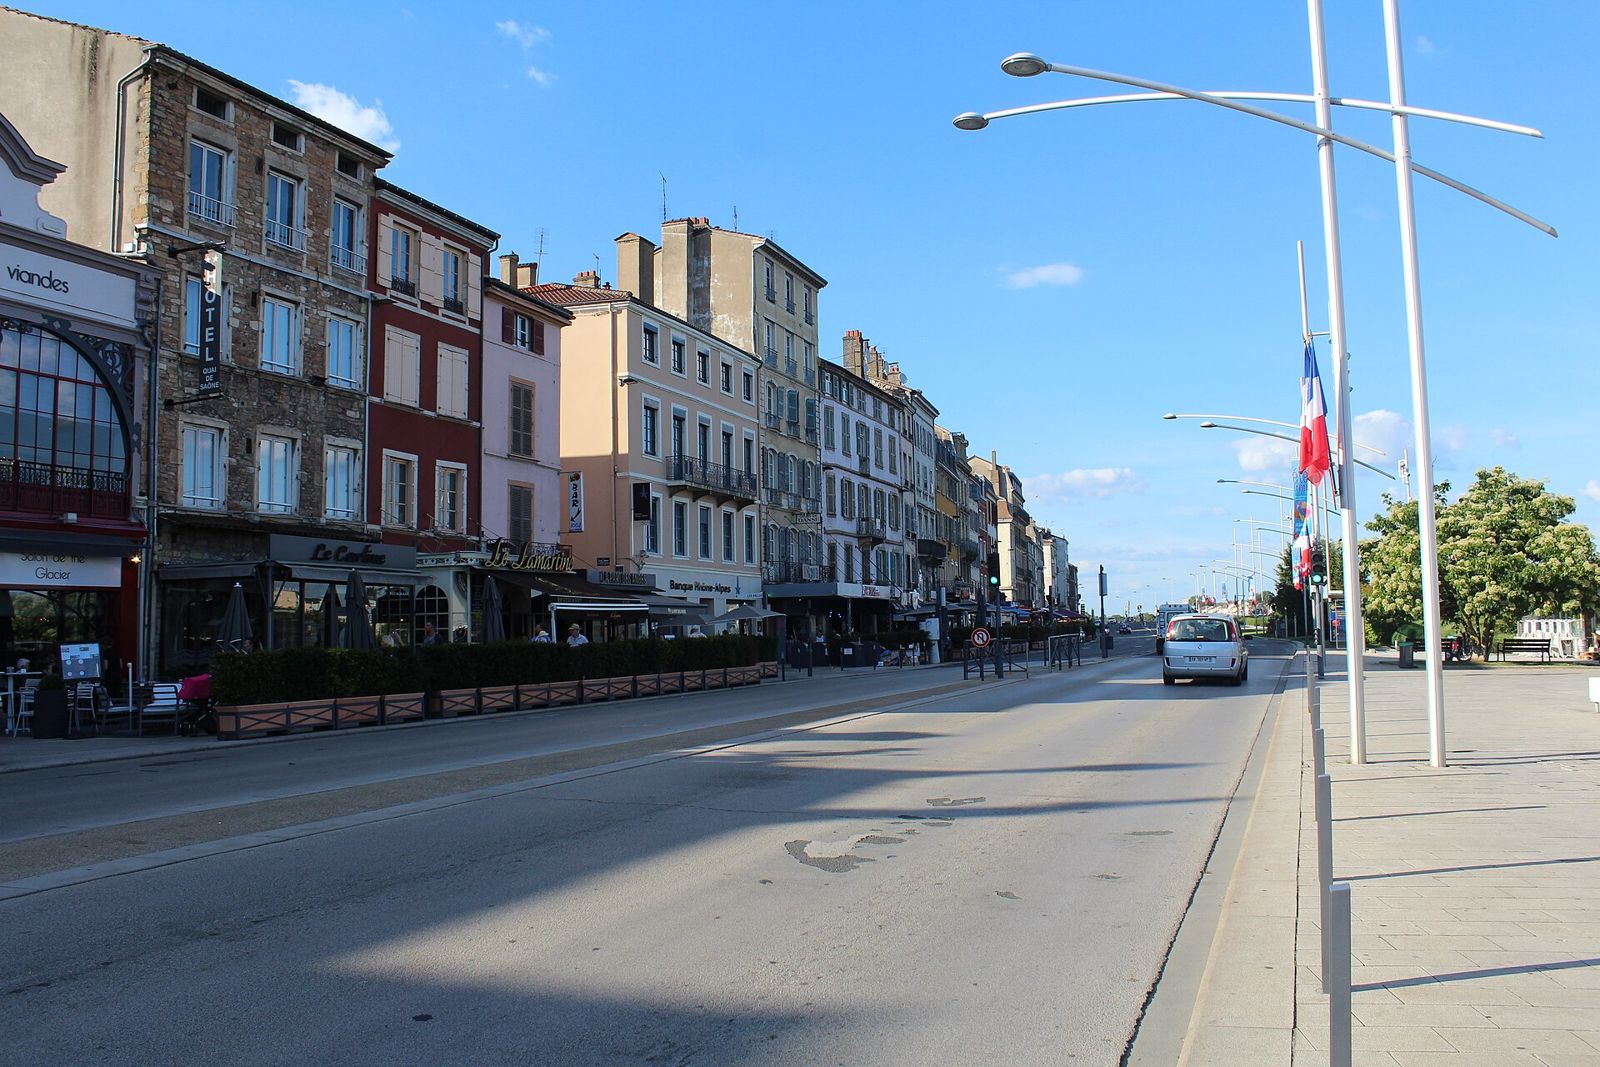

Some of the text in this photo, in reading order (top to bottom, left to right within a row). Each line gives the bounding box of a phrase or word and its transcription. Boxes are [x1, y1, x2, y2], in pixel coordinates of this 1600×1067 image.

[7, 264, 69, 294] viandes
[204, 269, 217, 362] HOTEL
[202, 367, 217, 375] QUAI
[200, 381, 219, 390] SAÔNE
[571, 483, 579, 507] BAR
[35, 566, 71, 580] Glacier
[669, 579, 693, 592] Banque
